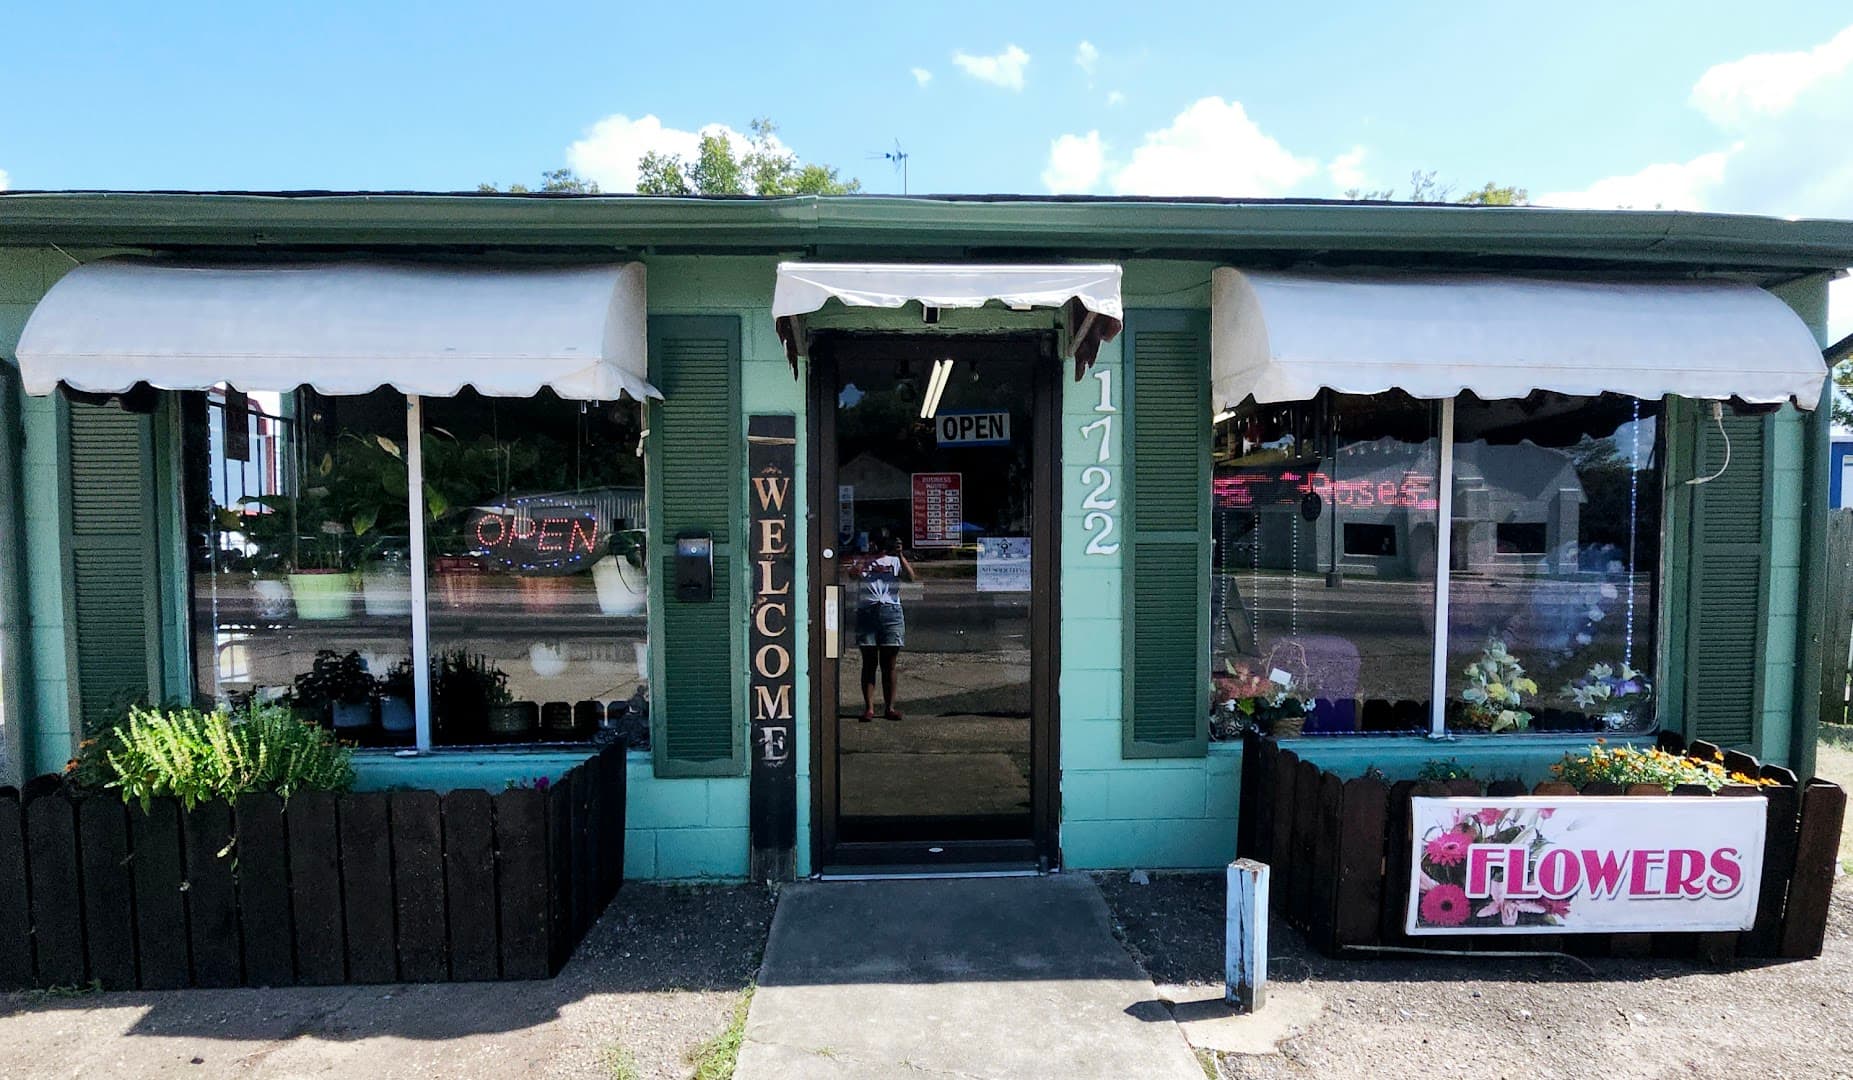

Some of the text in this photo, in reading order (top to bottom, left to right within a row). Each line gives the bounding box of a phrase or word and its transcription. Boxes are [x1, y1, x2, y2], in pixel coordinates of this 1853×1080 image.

[942, 414, 1004, 441] OPEN
[1080, 369, 1120, 556] 1722
[476, 513, 598, 553] OPEN
[751, 476, 792, 763] WELCOME
[1467, 846, 1744, 899] FLOWERS
